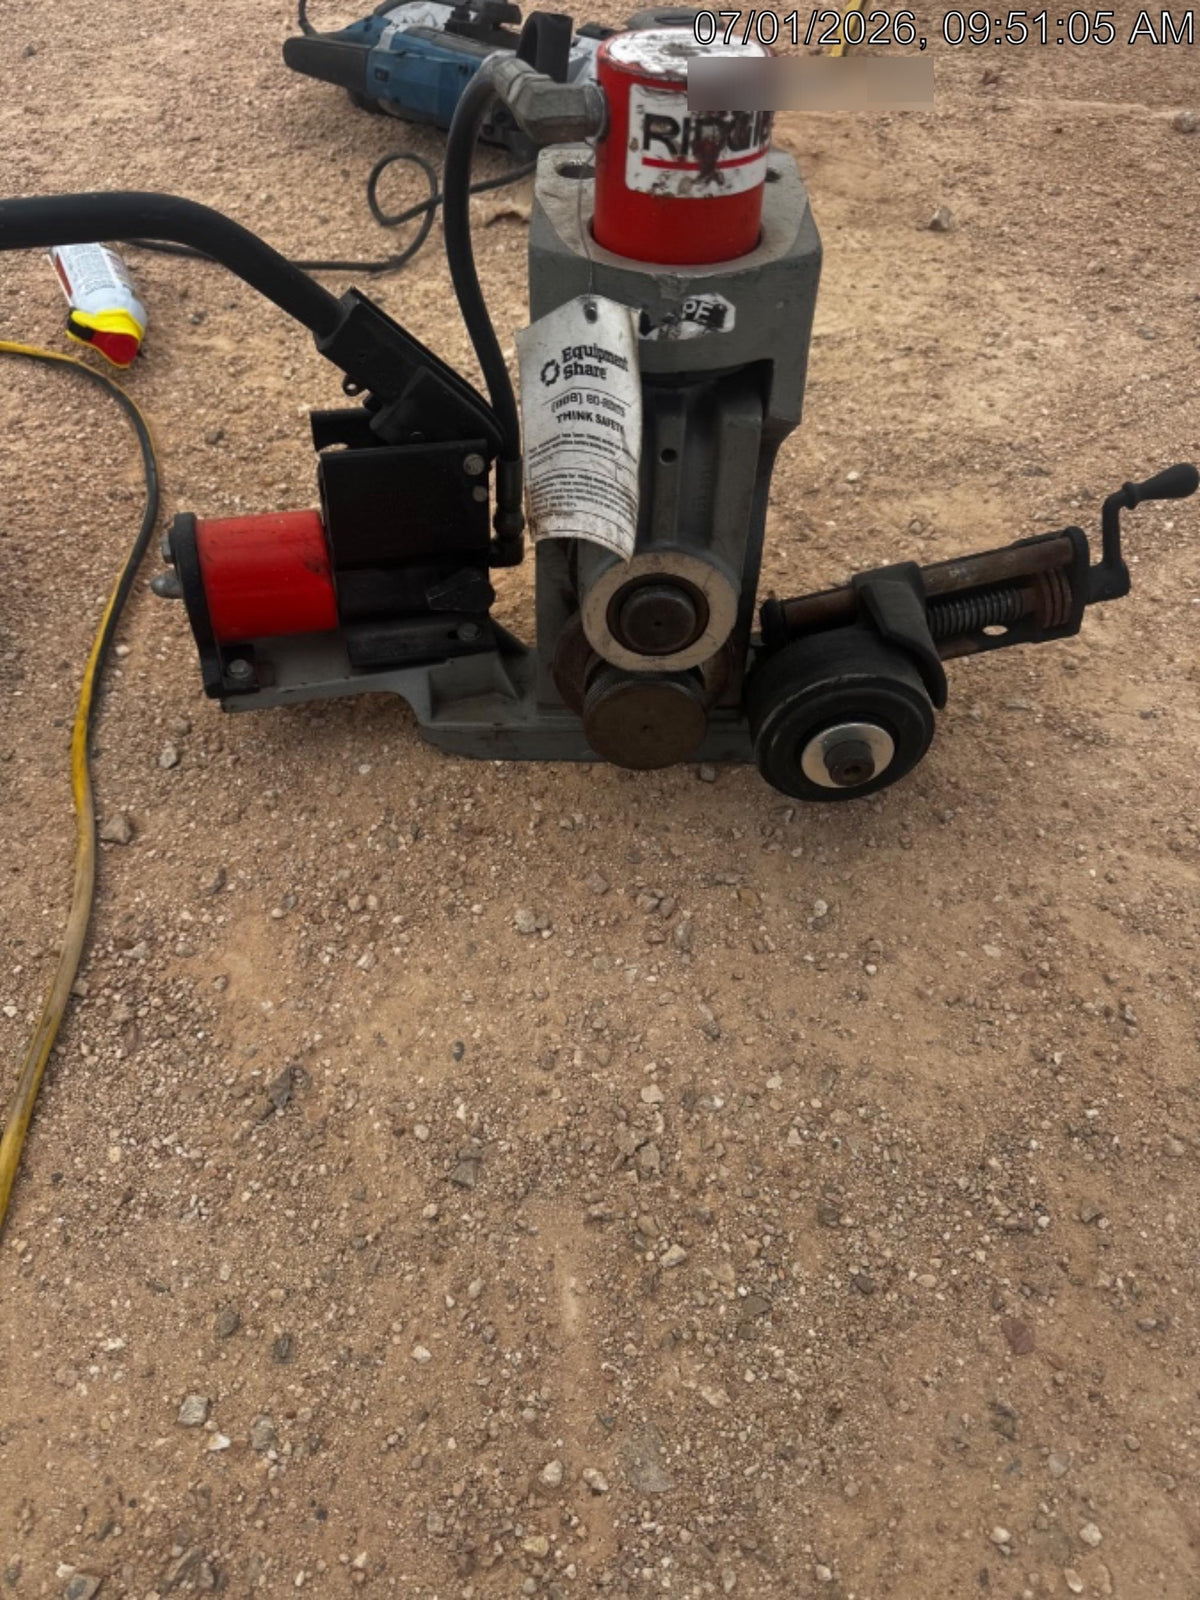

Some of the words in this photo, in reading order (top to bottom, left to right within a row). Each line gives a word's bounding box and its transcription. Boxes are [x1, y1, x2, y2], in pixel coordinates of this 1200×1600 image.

[562, 343, 629, 372] Equipment
[563, 361, 607, 381] Share
[556, 410, 594, 424] THINK
